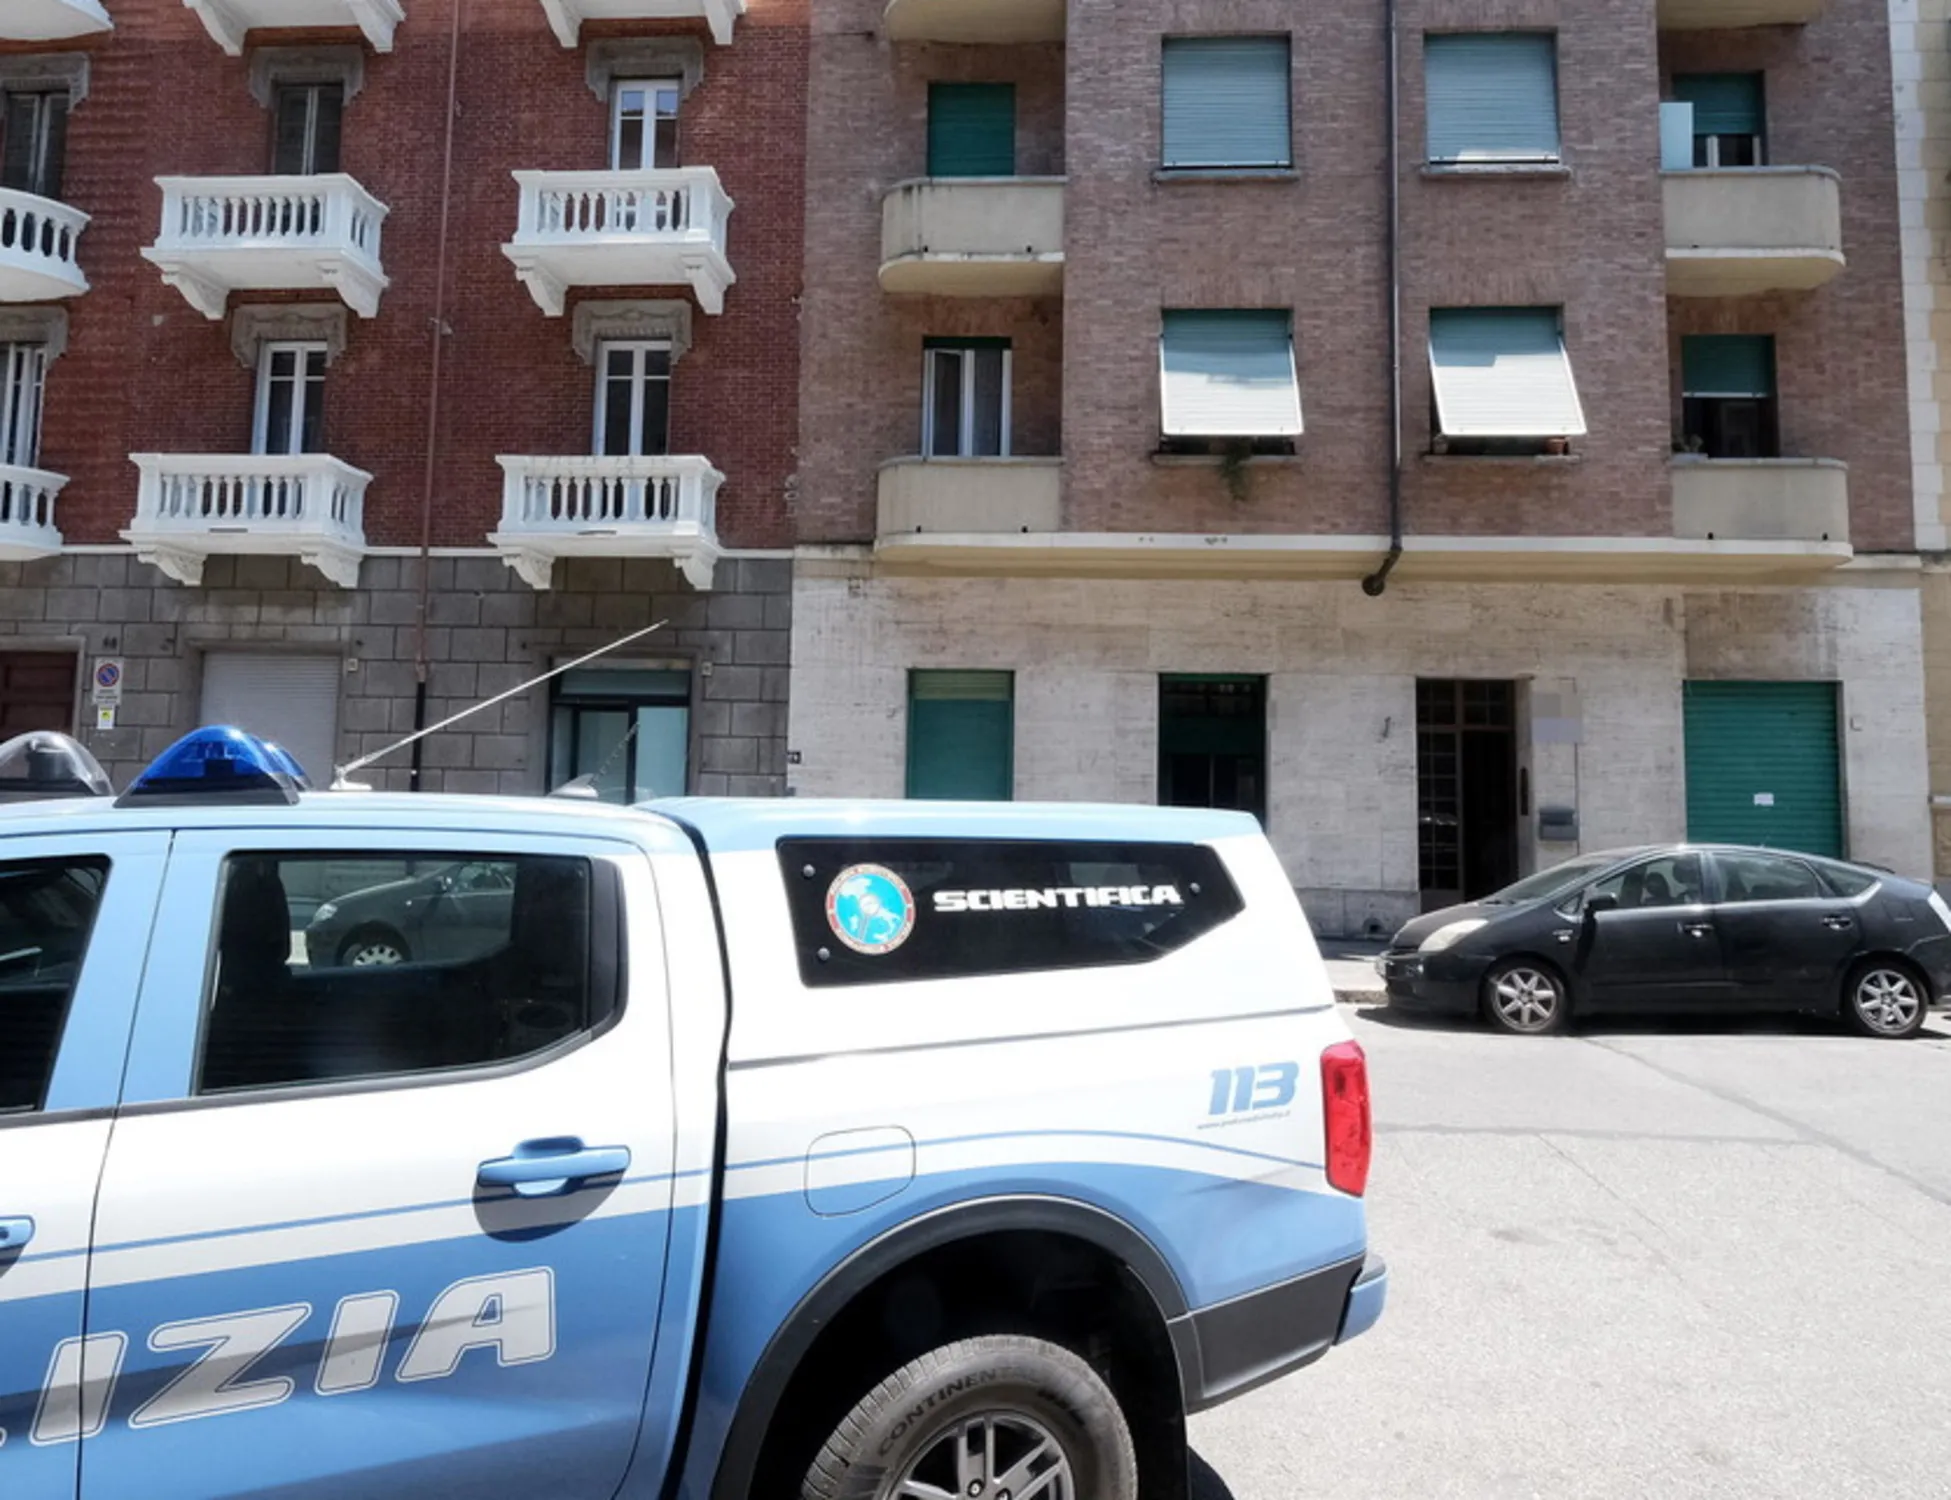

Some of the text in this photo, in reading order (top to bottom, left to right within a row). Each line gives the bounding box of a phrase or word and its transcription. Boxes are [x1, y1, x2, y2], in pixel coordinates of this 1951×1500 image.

[933, 885, 1184, 912] SCIENTIFICA
[1207, 1062, 1299, 1115] 113
[0, 1265, 556, 1448] IZIA
